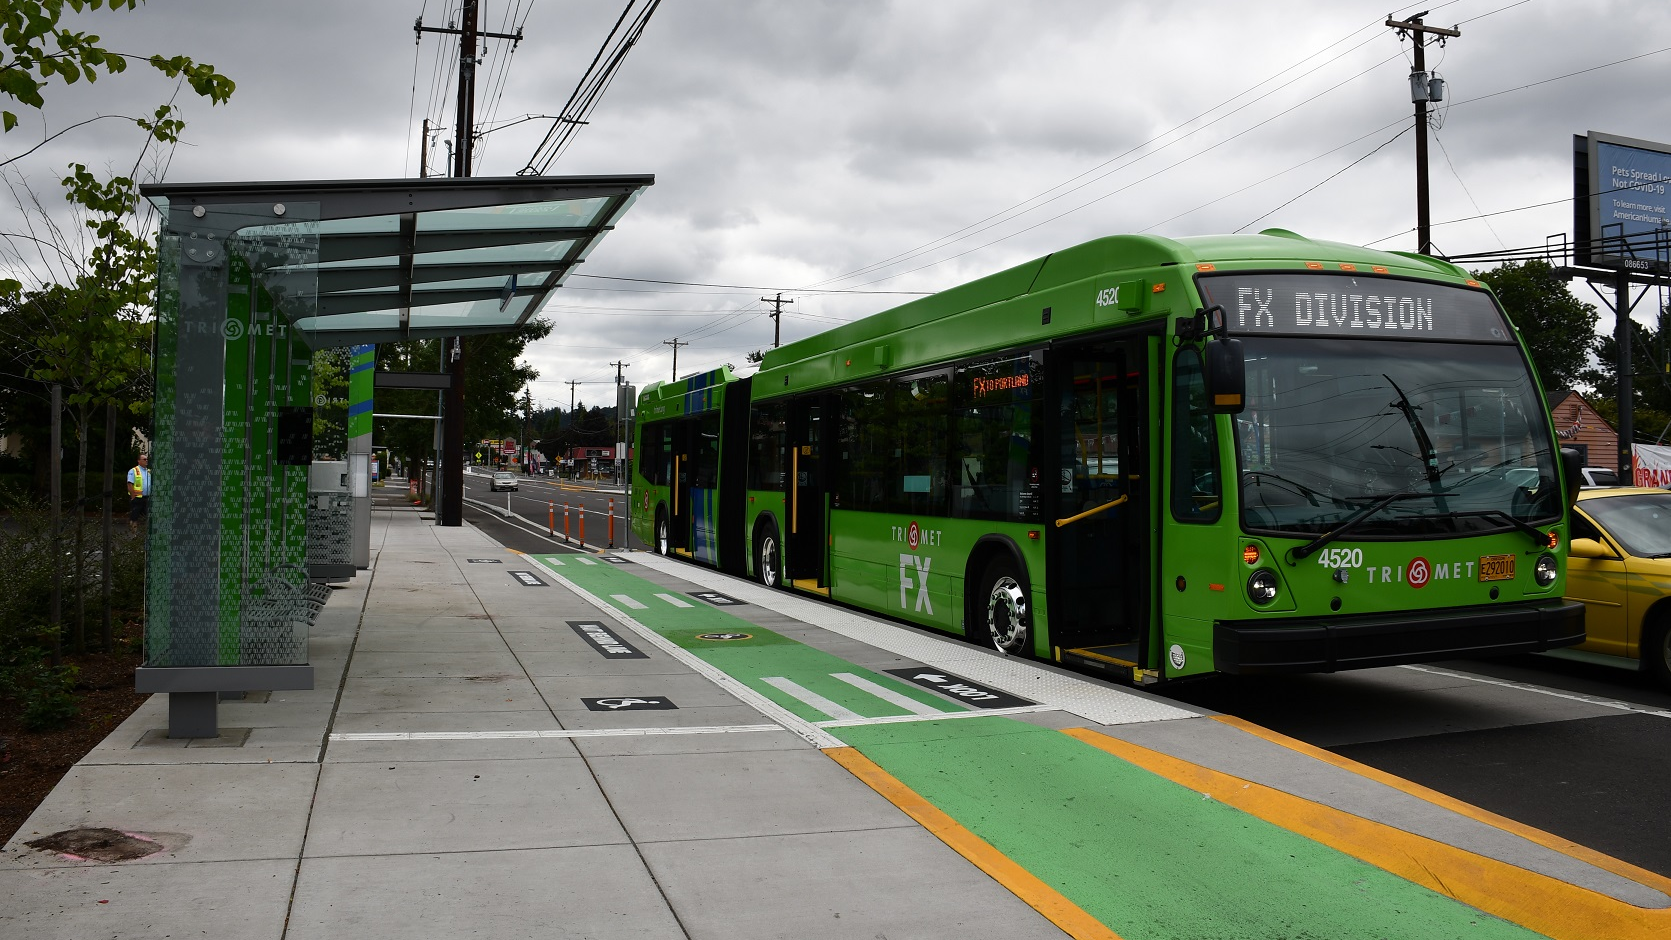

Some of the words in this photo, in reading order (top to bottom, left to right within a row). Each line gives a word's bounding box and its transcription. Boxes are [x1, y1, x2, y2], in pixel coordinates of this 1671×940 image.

[1612, 165, 1630, 177] Pets
[1630, 169, 1658, 182] Spread
[1612, 178, 1628, 189] Not
[1629, 180, 1665, 195] COVID-19
[1612, 199, 1621, 207] To
[1620, 200, 1637, 210] learn
[1624, 259, 1649, 270] 086653
[1238, 287, 1274, 327] FX
[1295, 292, 1433, 331] DIVISION
[973, 376, 987, 399] FX
[994, 373, 1029, 391] PORTLAND
[892, 526, 907, 542] TRI
[920, 529, 942, 547] MET
[1317, 548, 1363, 568] 4520
[1366, 565, 1402, 583] TRI
[1434, 562, 1475, 580] MET
[1481, 560, 1514, 576] E292010
[900, 553, 934, 615] FX
[937, 683, 999, 701] LOOK
